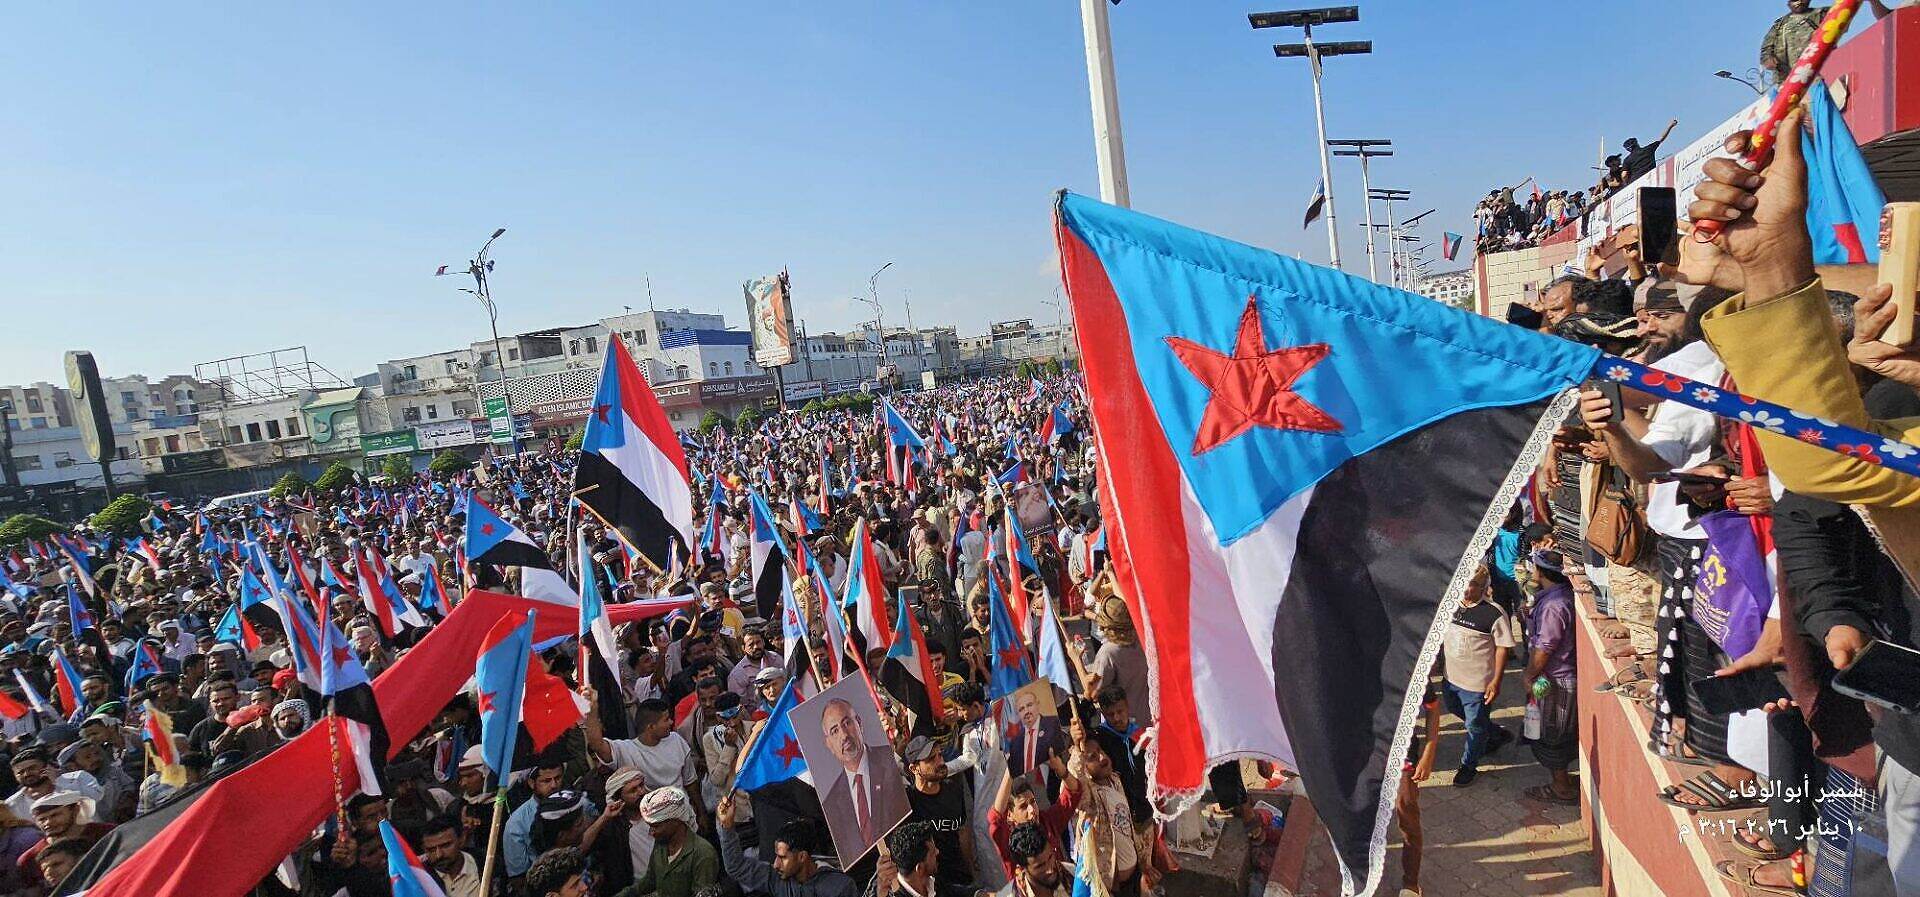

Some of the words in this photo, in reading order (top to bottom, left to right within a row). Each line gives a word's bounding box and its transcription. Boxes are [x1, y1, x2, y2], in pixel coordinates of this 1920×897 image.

[538, 404, 556, 414] ADEN
[556, 401, 583, 412] ISLAMIC
[582, 400, 593, 409] BA
